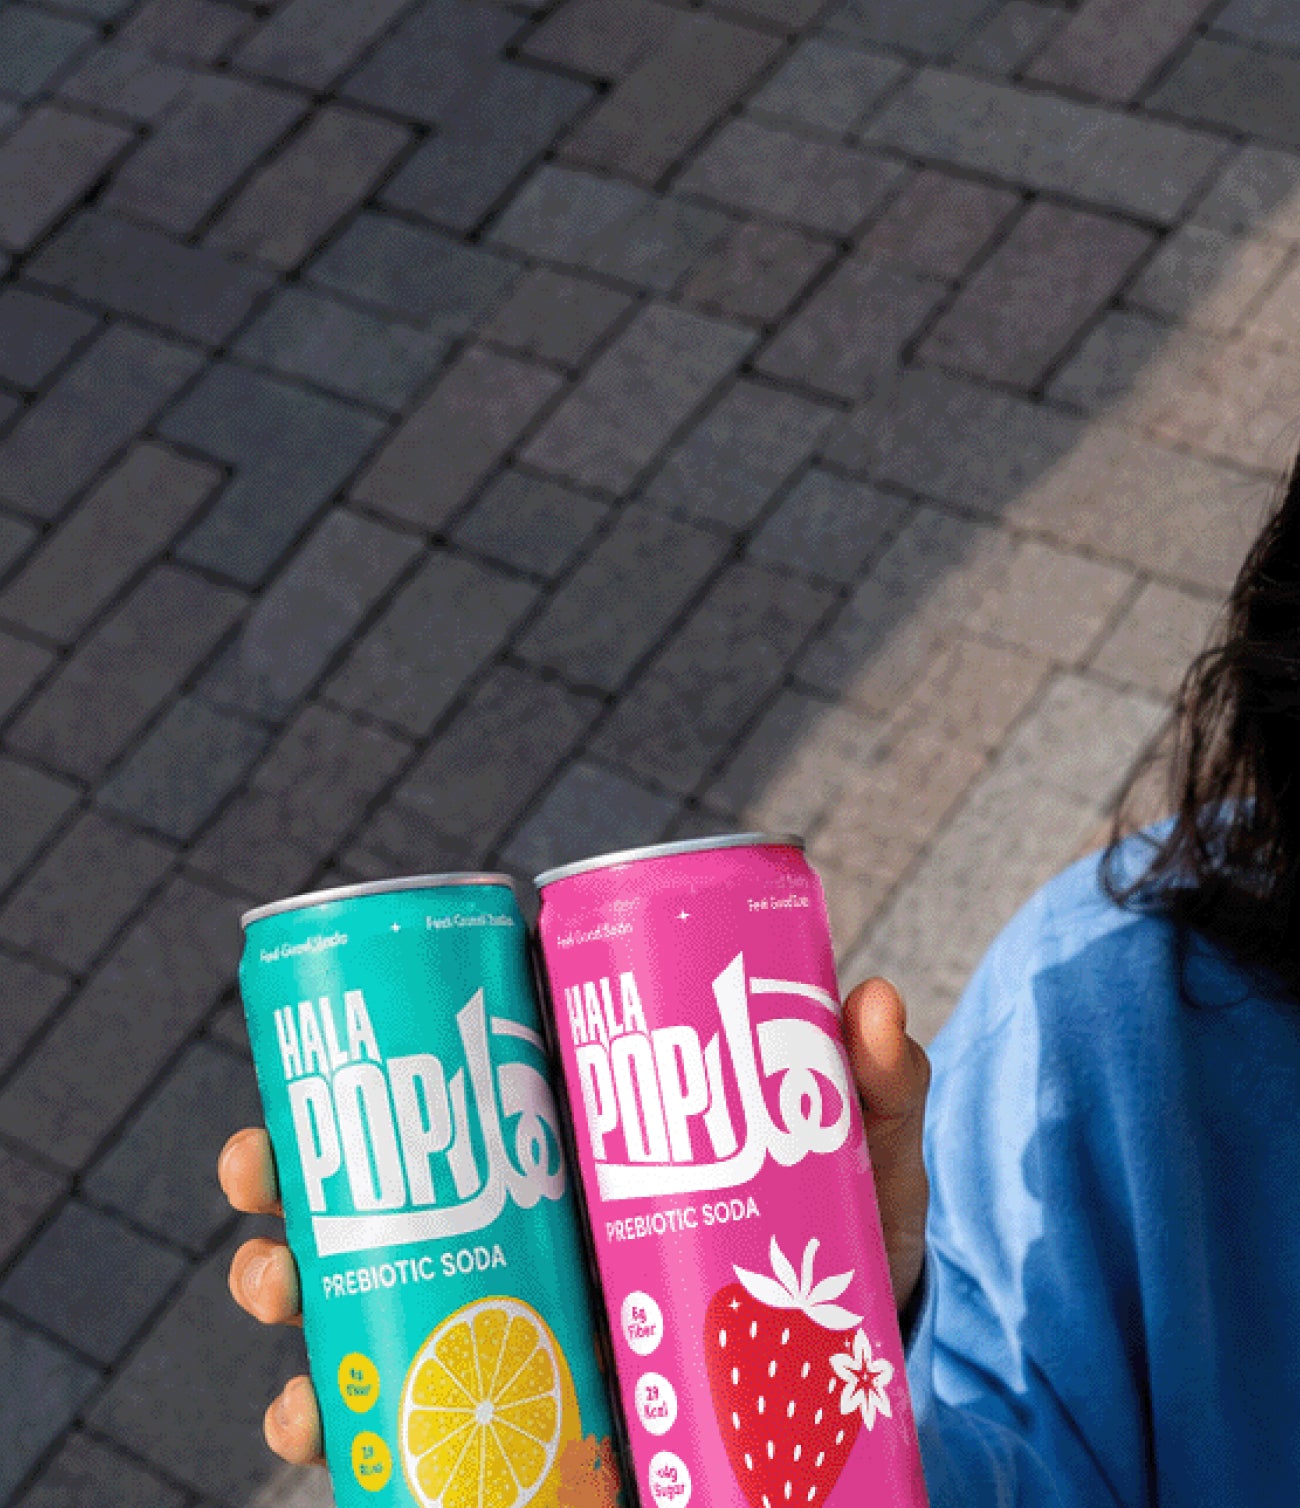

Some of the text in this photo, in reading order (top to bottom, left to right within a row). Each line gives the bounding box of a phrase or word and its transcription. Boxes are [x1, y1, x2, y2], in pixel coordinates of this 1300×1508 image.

[273, 989, 381, 1081] HALA
[564, 971, 647, 1046] HALA
[287, 1053, 452, 1213] POP
[575, 1025, 711, 1162] POP
[606, 1197, 760, 1243] PREBIOTIC SODA
[323, 1244, 507, 1298] PREBIOTIC SODA
